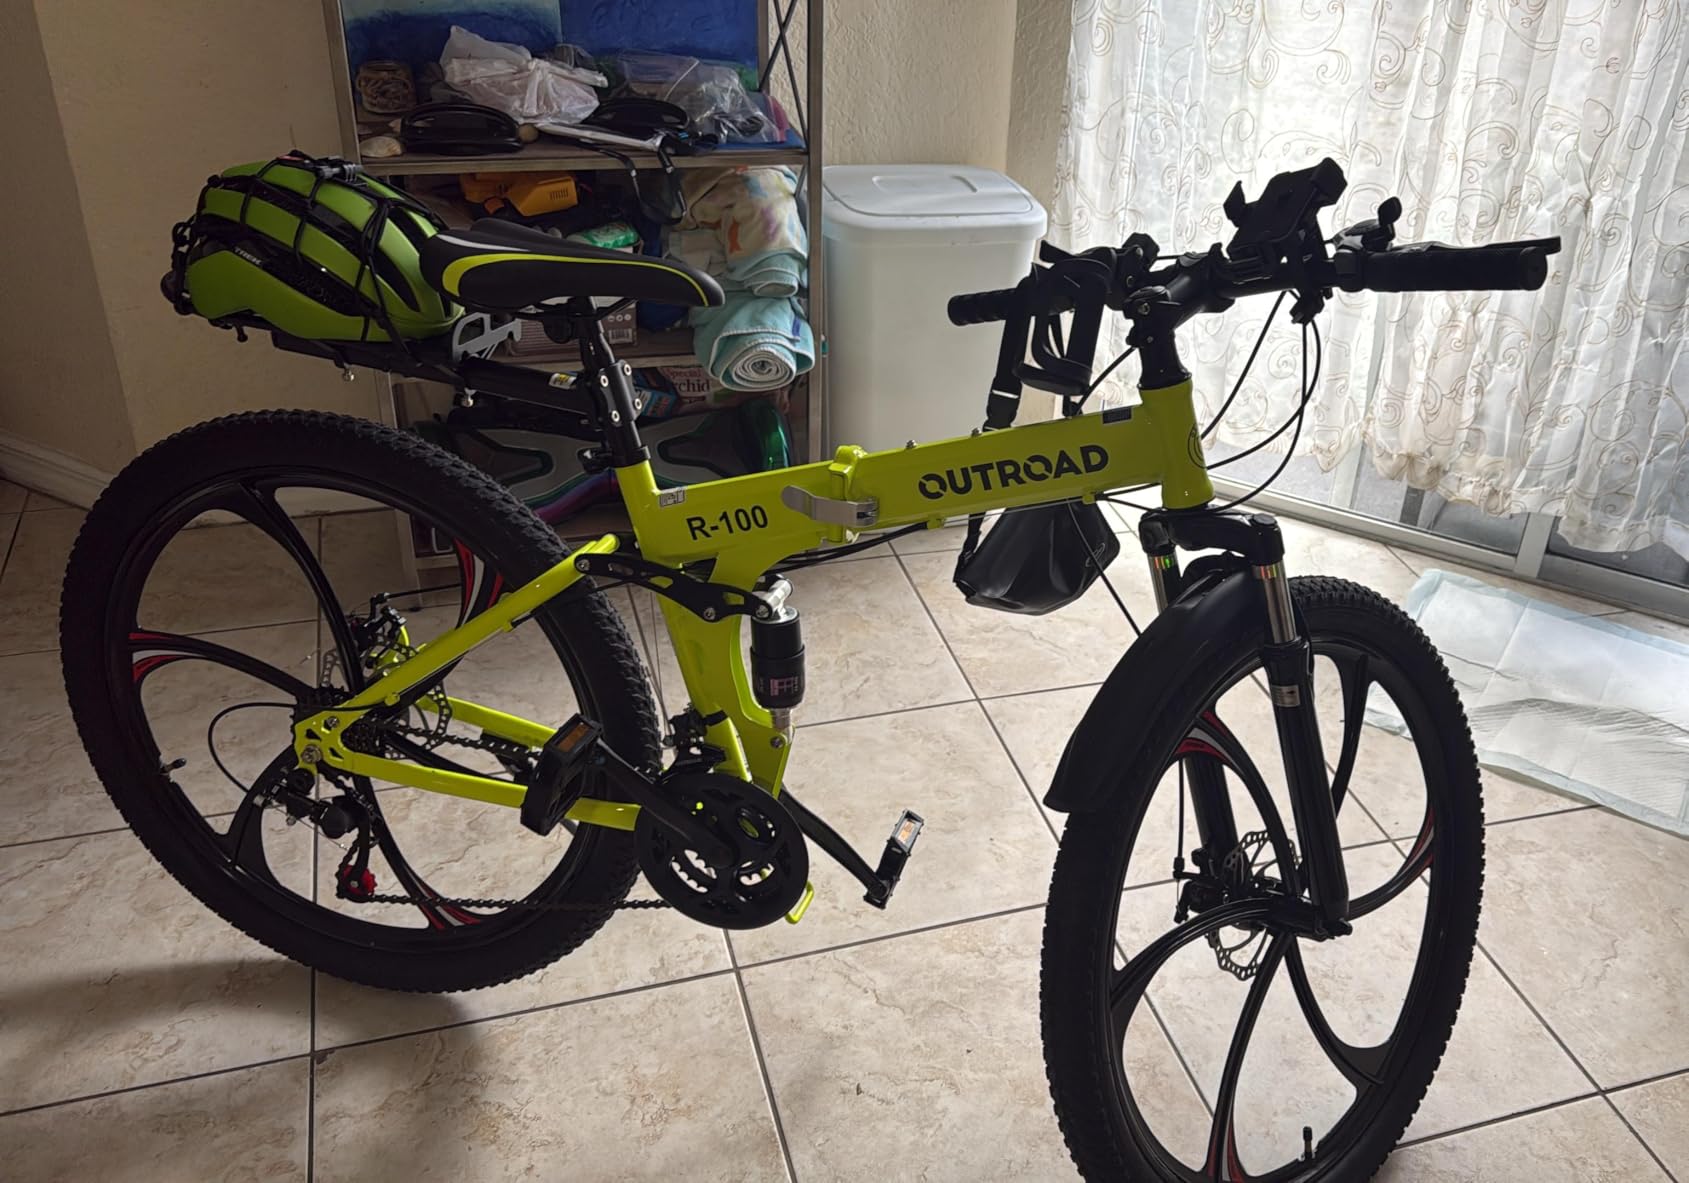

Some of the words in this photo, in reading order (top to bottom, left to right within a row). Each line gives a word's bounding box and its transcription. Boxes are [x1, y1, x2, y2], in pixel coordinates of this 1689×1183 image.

[672, 379, 710, 392] rchid
[919, 445, 1108, 499] OUTROAD
[686, 505, 768, 541] R-100
